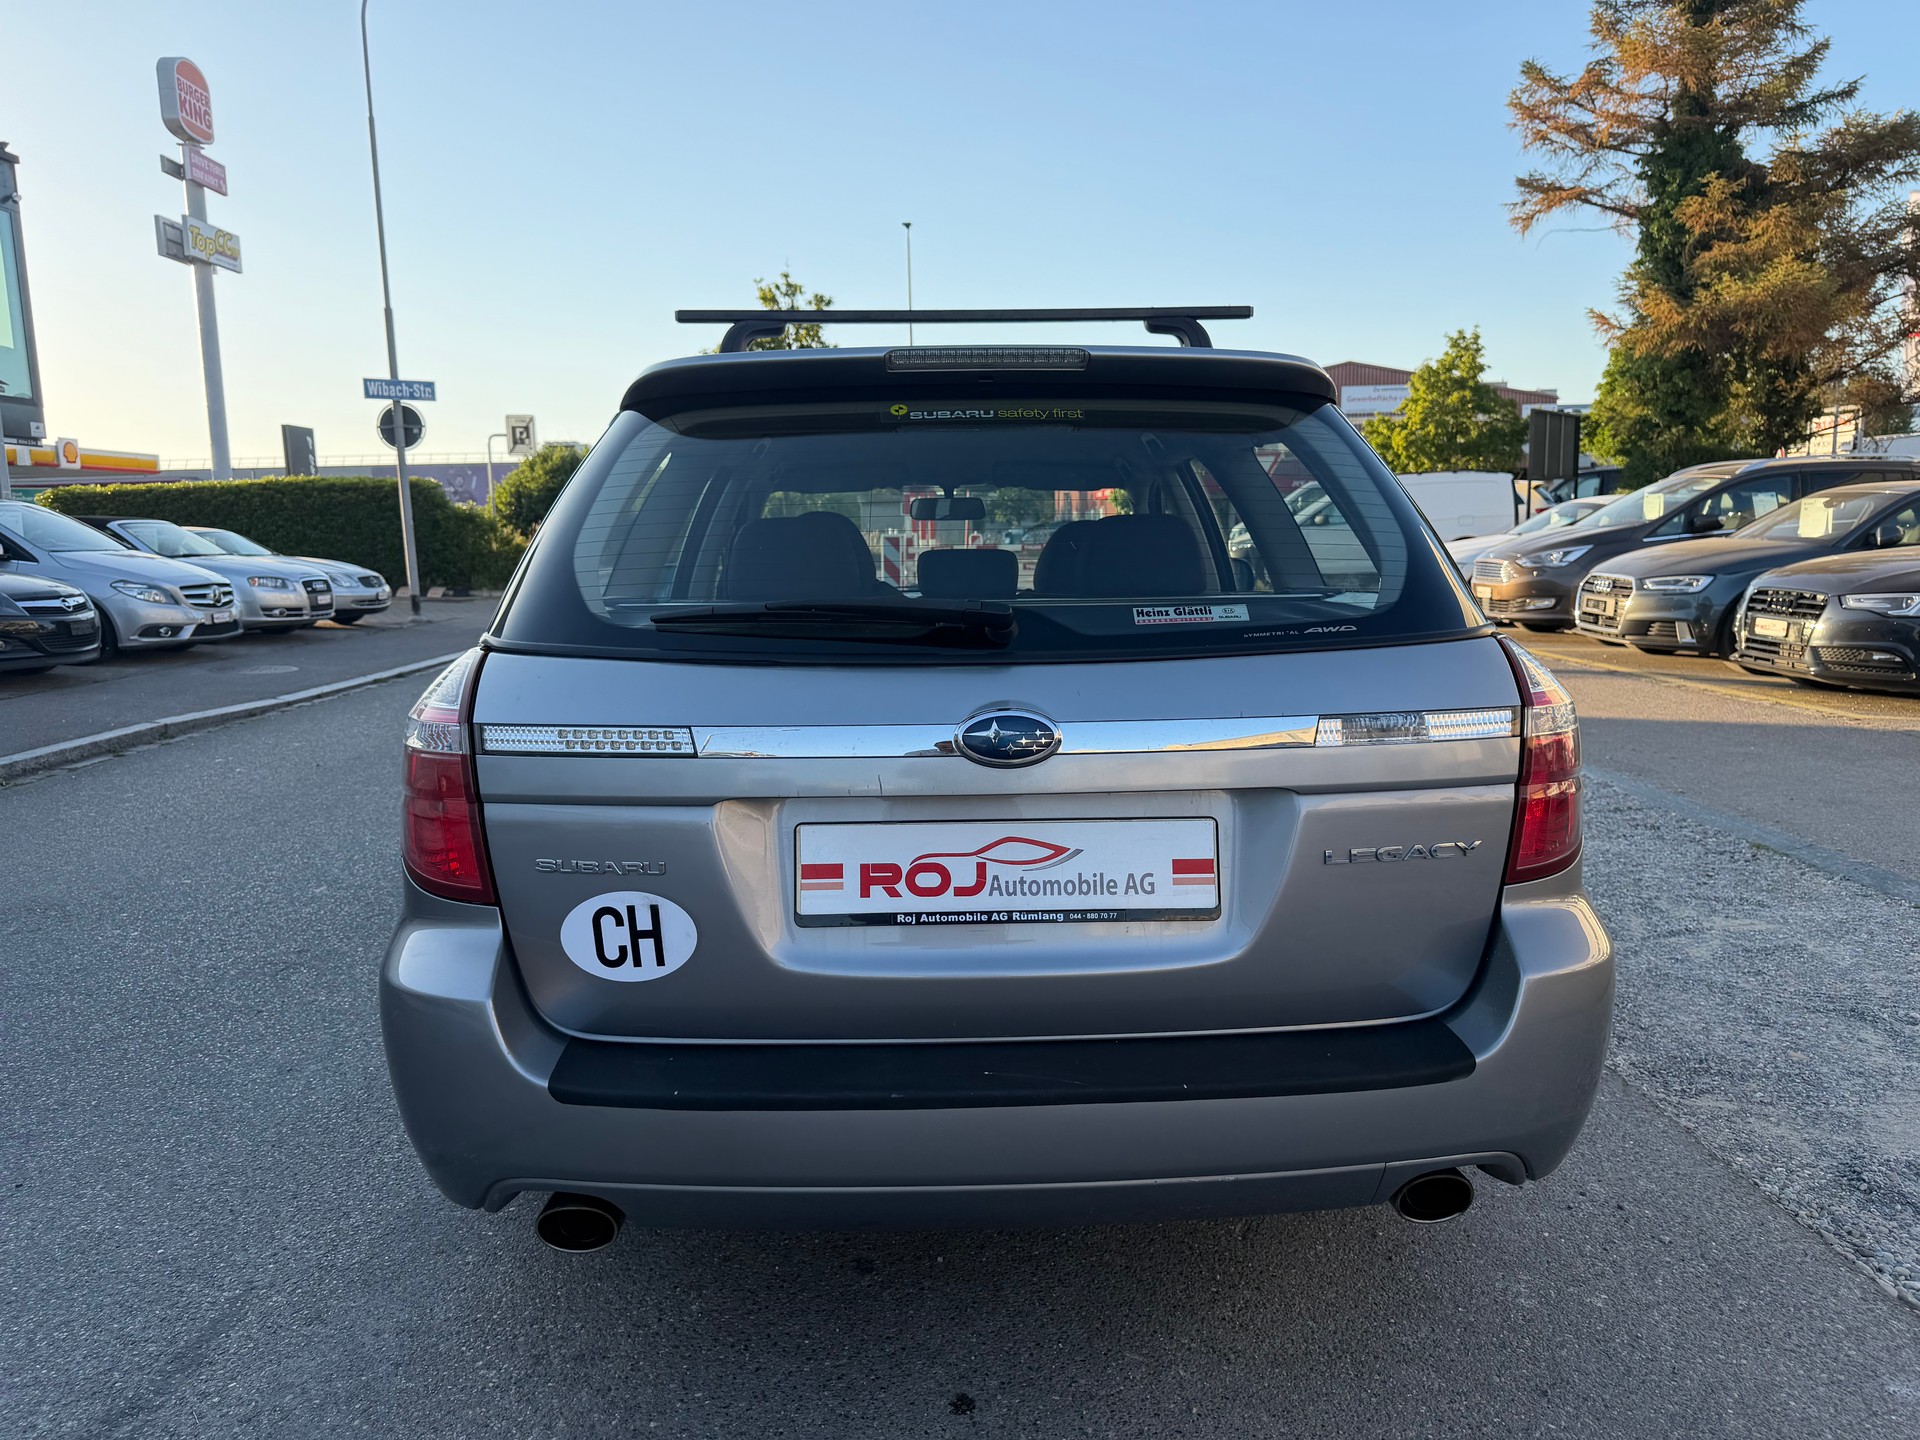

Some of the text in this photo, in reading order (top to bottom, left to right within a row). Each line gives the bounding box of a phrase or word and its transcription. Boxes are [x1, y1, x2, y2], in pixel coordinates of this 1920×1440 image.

[177, 77, 210, 110] BURGER
[179, 93, 212, 130] KING
[366, 381, 432, 398] Wibach-Str.
[909, 408, 1084, 420] SUBARU safety first
[1136, 606, 1212, 618] Heinz Glättli
[1304, 624, 1357, 634] AWD
[1324, 840, 1483, 865] LEGACY
[535, 858, 667, 876] SUBARU
[859, 861, 1156, 899] ROJ Automobile AG
[896, 914, 917, 925] Roj
[920, 913, 989, 924] Automobile
[992, 912, 1008, 922] AG
[1013, 911, 1064, 923] Rümlang
[1086, 912, 1098, 920] 880
[1100, 912, 1108, 920] 70
[1109, 912, 1118, 920] 77
[592, 904, 666, 969] CH
